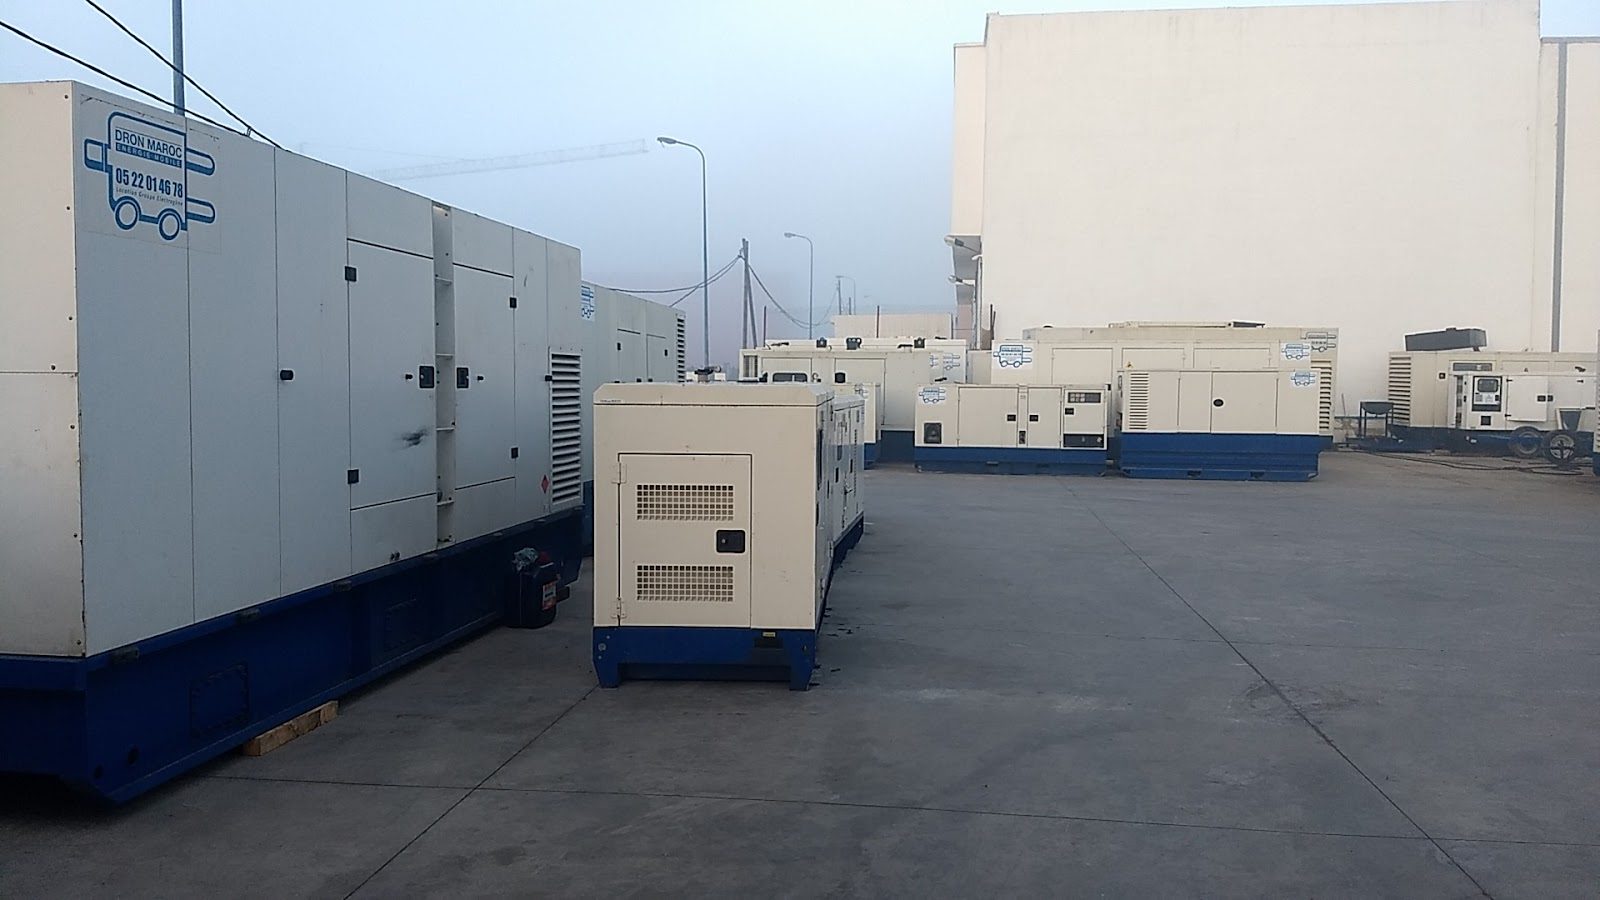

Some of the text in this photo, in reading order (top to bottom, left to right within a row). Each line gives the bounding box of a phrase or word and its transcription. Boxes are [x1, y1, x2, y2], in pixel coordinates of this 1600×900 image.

[115, 129, 182, 158] DRON MAROC
[154, 154, 181, 166] MOBILE
[116, 168, 183, 198] 05 22 01 46 78
